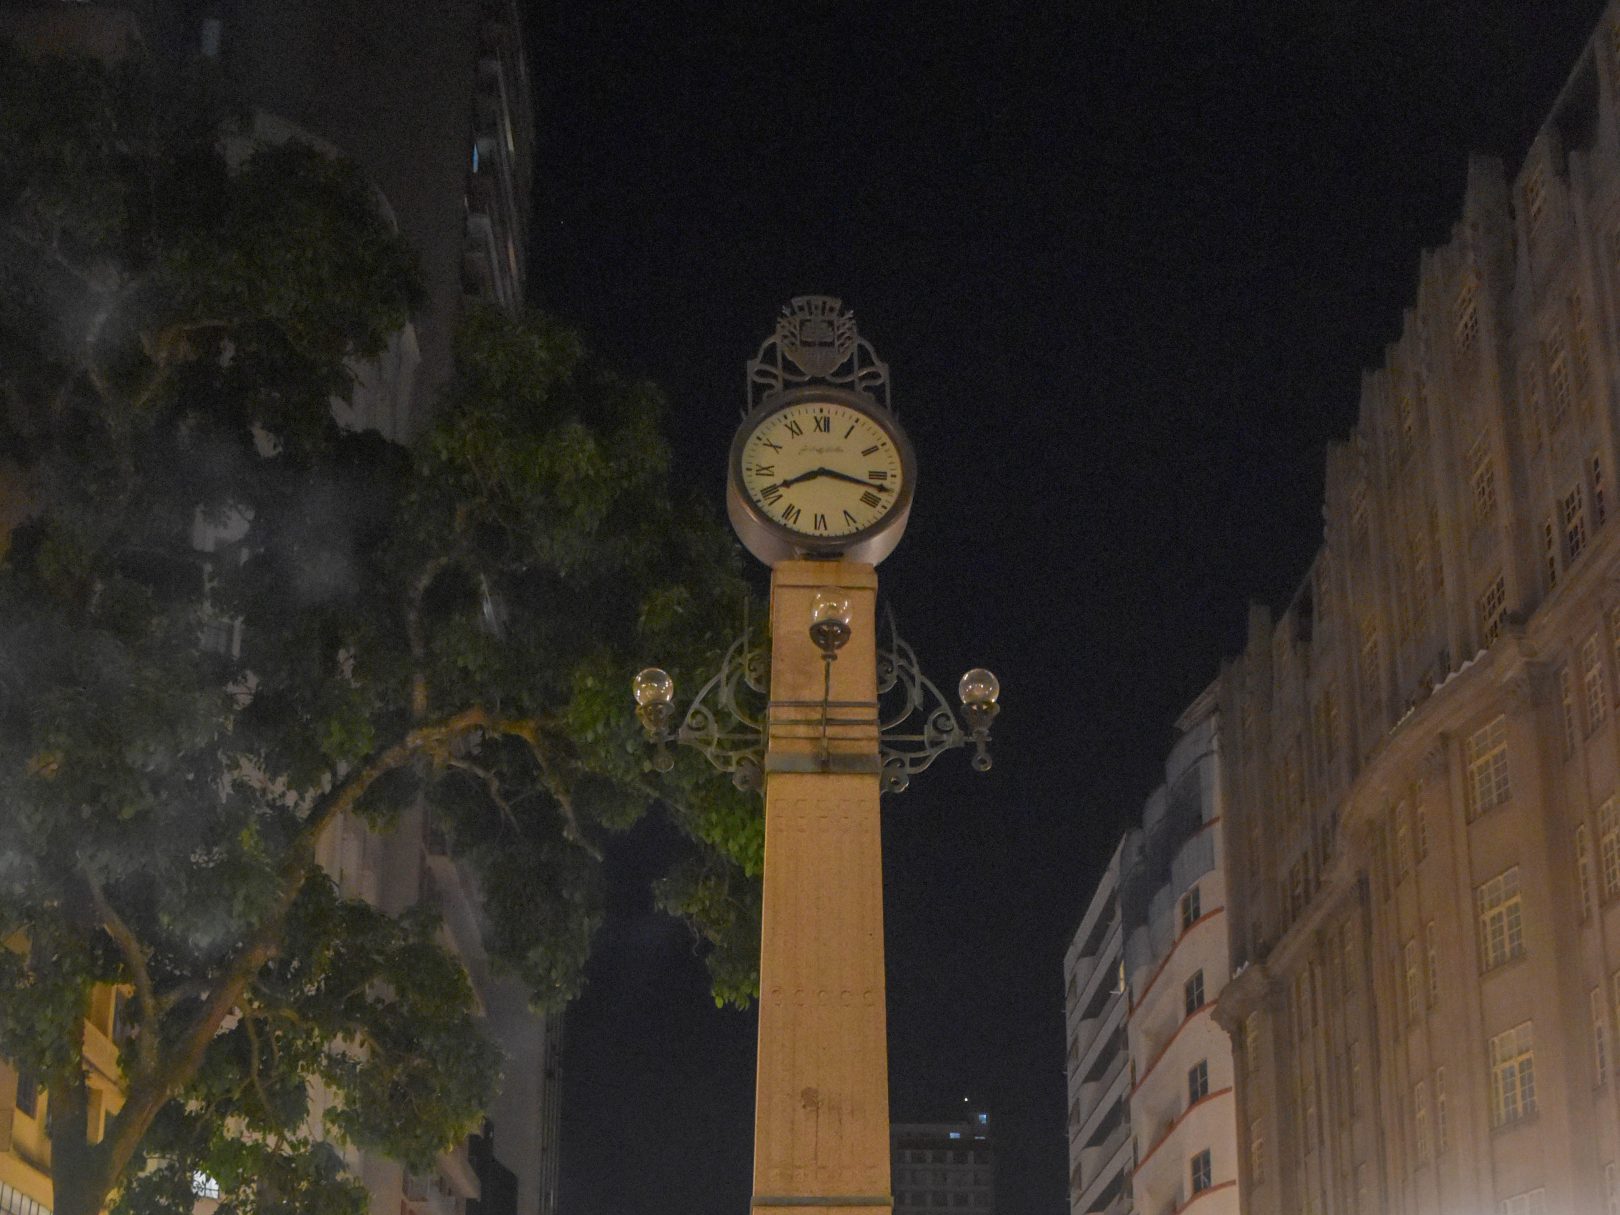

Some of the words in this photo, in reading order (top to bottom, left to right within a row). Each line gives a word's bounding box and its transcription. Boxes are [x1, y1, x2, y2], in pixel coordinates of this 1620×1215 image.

[784, 420, 804, 439] XI
[814, 416, 830, 433] XII
[762, 438, 783, 455] X
[861, 445, 880, 457] II
[755, 464, 775, 477] IX
[868, 471, 888, 481] III
[781, 504, 802, 525] VII
[814, 513, 828, 531] VI
[842, 509, 856, 528] V
